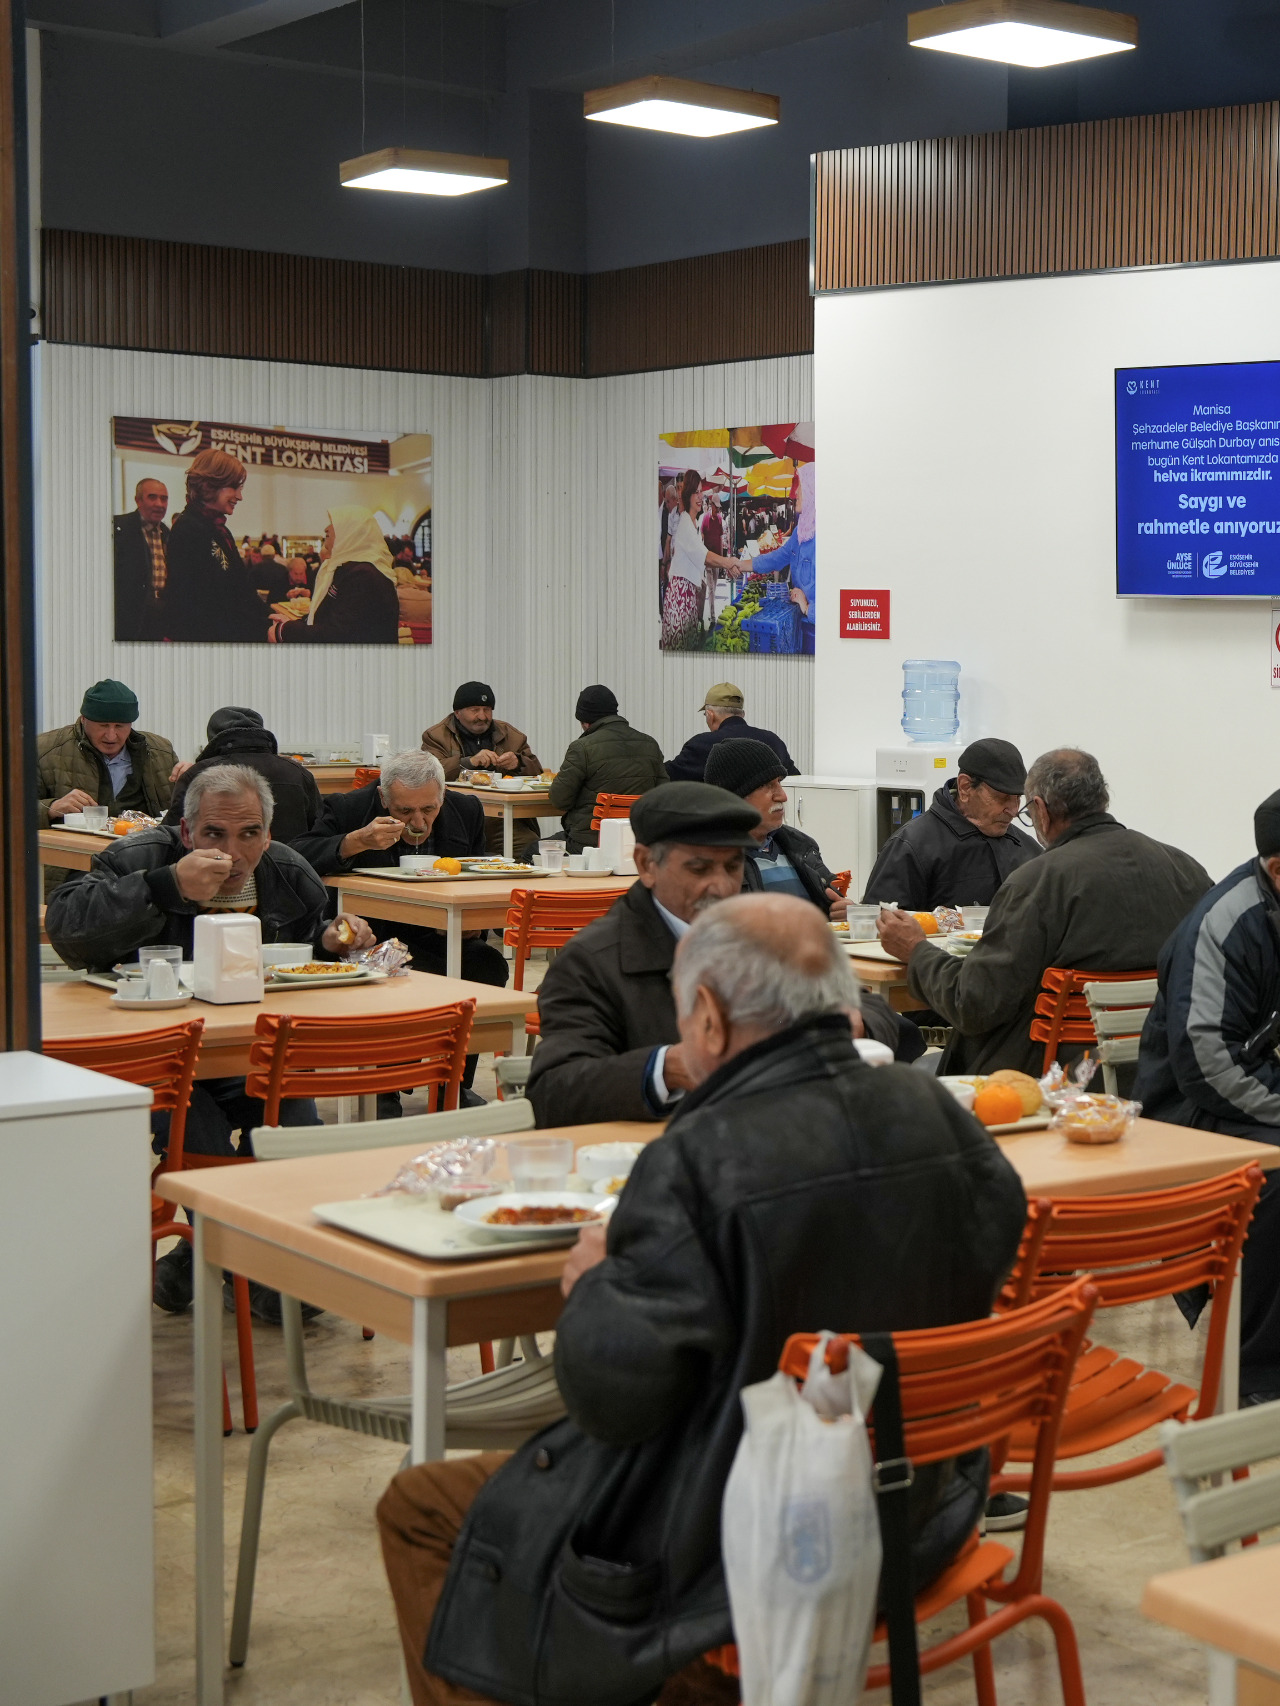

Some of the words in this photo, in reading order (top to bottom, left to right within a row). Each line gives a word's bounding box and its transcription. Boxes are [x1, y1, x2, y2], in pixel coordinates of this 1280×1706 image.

[1139, 379, 1160, 389] KENT
[1193, 404, 1231, 416] Manisa
[1132, 422, 1188, 435] Şehzadeler
[1190, 421, 1233, 433] Belediye
[211, 429, 263, 445] ESKİŞEHİR
[1131, 439, 1179, 450] merhume
[1181, 438, 1216, 450] Gülşah
[1218, 437, 1255, 449] Durbay
[272, 448, 369, 474] LOKANTASI
[1148, 455, 1180, 469] bugün
[1182, 455, 1205, 466] Kent
[1206, 453, 1279, 465] Lokantamızda
[1153, 469, 1188, 483] helva
[1190, 468, 1273, 482] ikramımızdır.
[1178, 493, 1223, 512] Saygı
[1226, 495, 1247, 509] ve
[1137, 518, 1210, 535] rahmetle
[1175, 552, 1192, 561] AYŞE
[1166, 560, 1192, 570] ÜNLÜCE
[850, 598, 879, 608] SUYUNUZU,
[848, 610, 881, 619] SEBİLLERDEN
